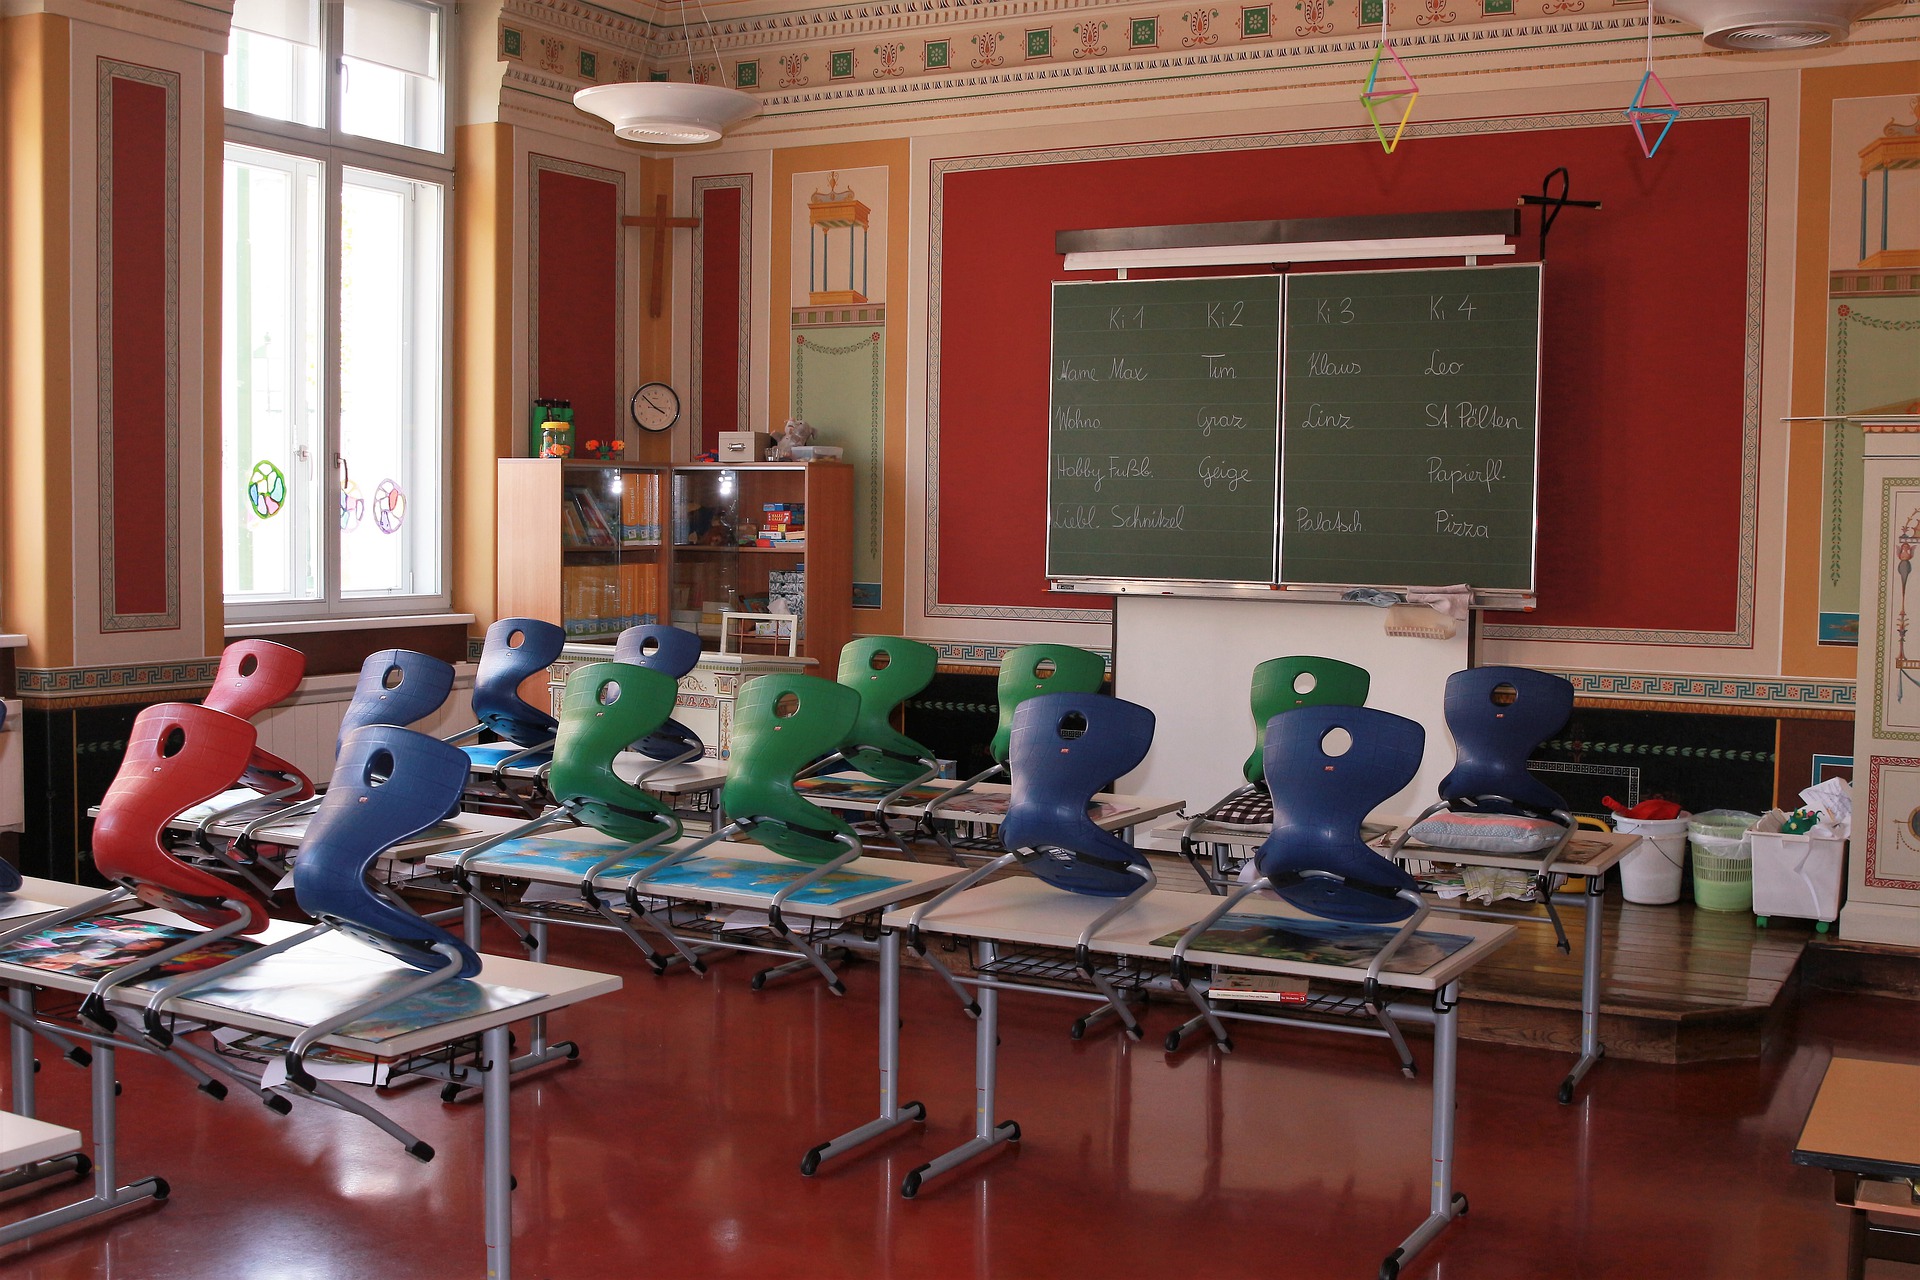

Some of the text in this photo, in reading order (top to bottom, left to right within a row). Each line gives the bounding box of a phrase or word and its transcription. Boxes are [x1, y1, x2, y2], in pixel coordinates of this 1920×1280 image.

[1109, 305, 1144, 330] Ki 1
[1316, 297, 1355, 324] Ki 3
[1457, 294, 1478, 321] 4
[1108, 357, 1148, 382] Max
[1201, 353, 1237, 379] Tim
[1308, 352, 1362, 377] Klaus
[1424, 349, 1464, 376] Leo
[1197, 406, 1247, 437] Graz
[1302, 403, 1354, 429] Linz
[1455, 401, 1523, 430] Pölten
[1057, 454, 1105, 492] Hobby
[1198, 455, 1252, 492] Geige
[1435, 509, 1489, 538] Pizza
